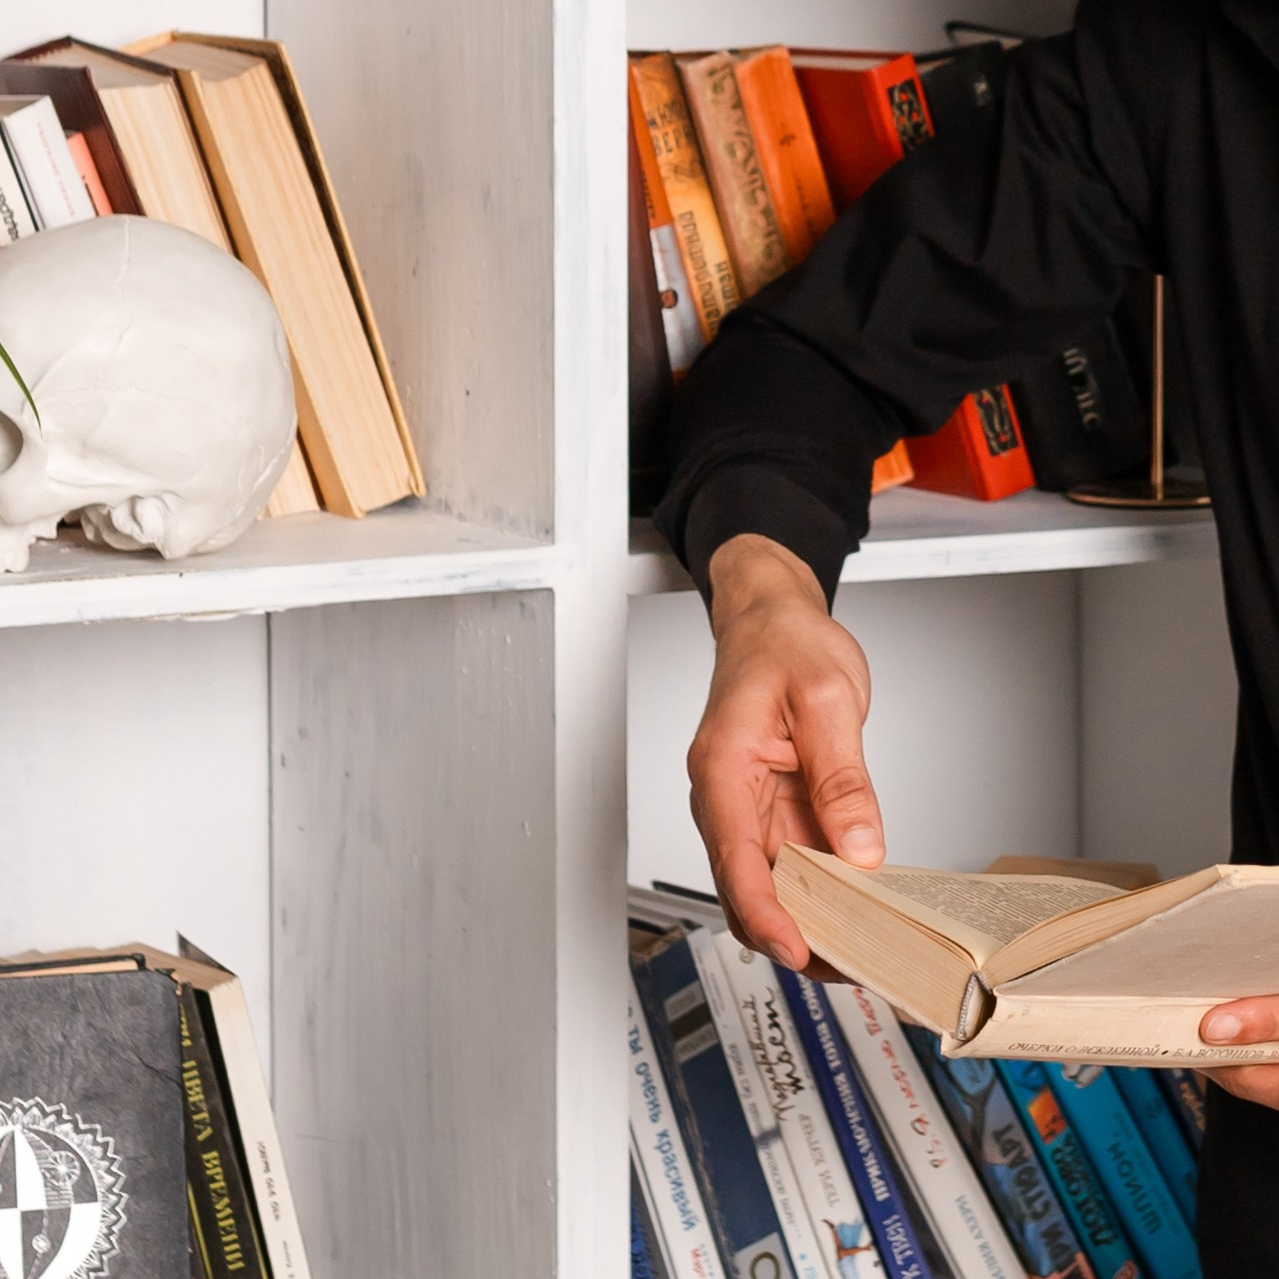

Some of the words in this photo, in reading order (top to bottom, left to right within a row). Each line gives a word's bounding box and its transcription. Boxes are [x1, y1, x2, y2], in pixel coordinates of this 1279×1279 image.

[628, 1024, 643, 1056] ты
[1008, 1041, 1064, 1054] ОЧЕРКИ
[1079, 1043, 1161, 1058] ВСЕЛЕННОЙ
[634, 1063, 660, 1126] очень
[183, 1058, 216, 1143] ЦВЕТА
[200, 1147, 246, 1274] ВРЕМЕНИ
[652, 1127, 698, 1233] красивый
[989, 1128, 1055, 1221] СТЮАРТ
